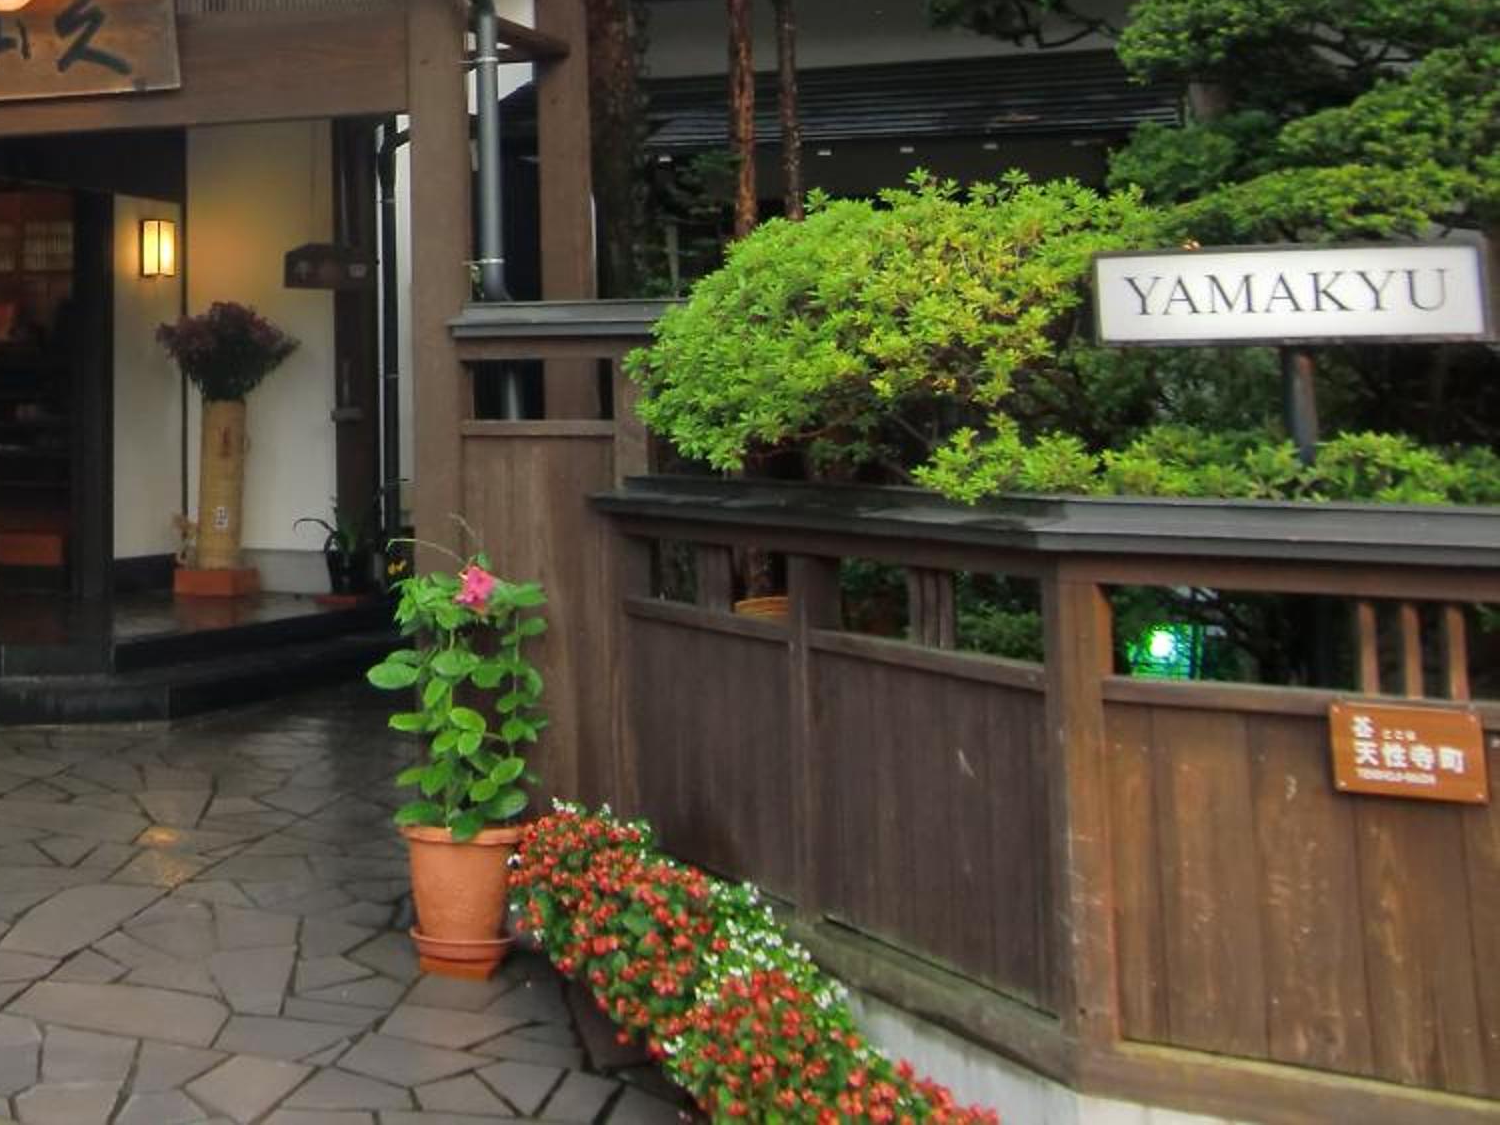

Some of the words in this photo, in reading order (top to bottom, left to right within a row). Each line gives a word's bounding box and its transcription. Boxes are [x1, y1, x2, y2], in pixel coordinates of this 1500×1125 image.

[1123, 267, 1451, 317] YAMAKYU
[1353, 739, 1465, 774] 天性寺町
